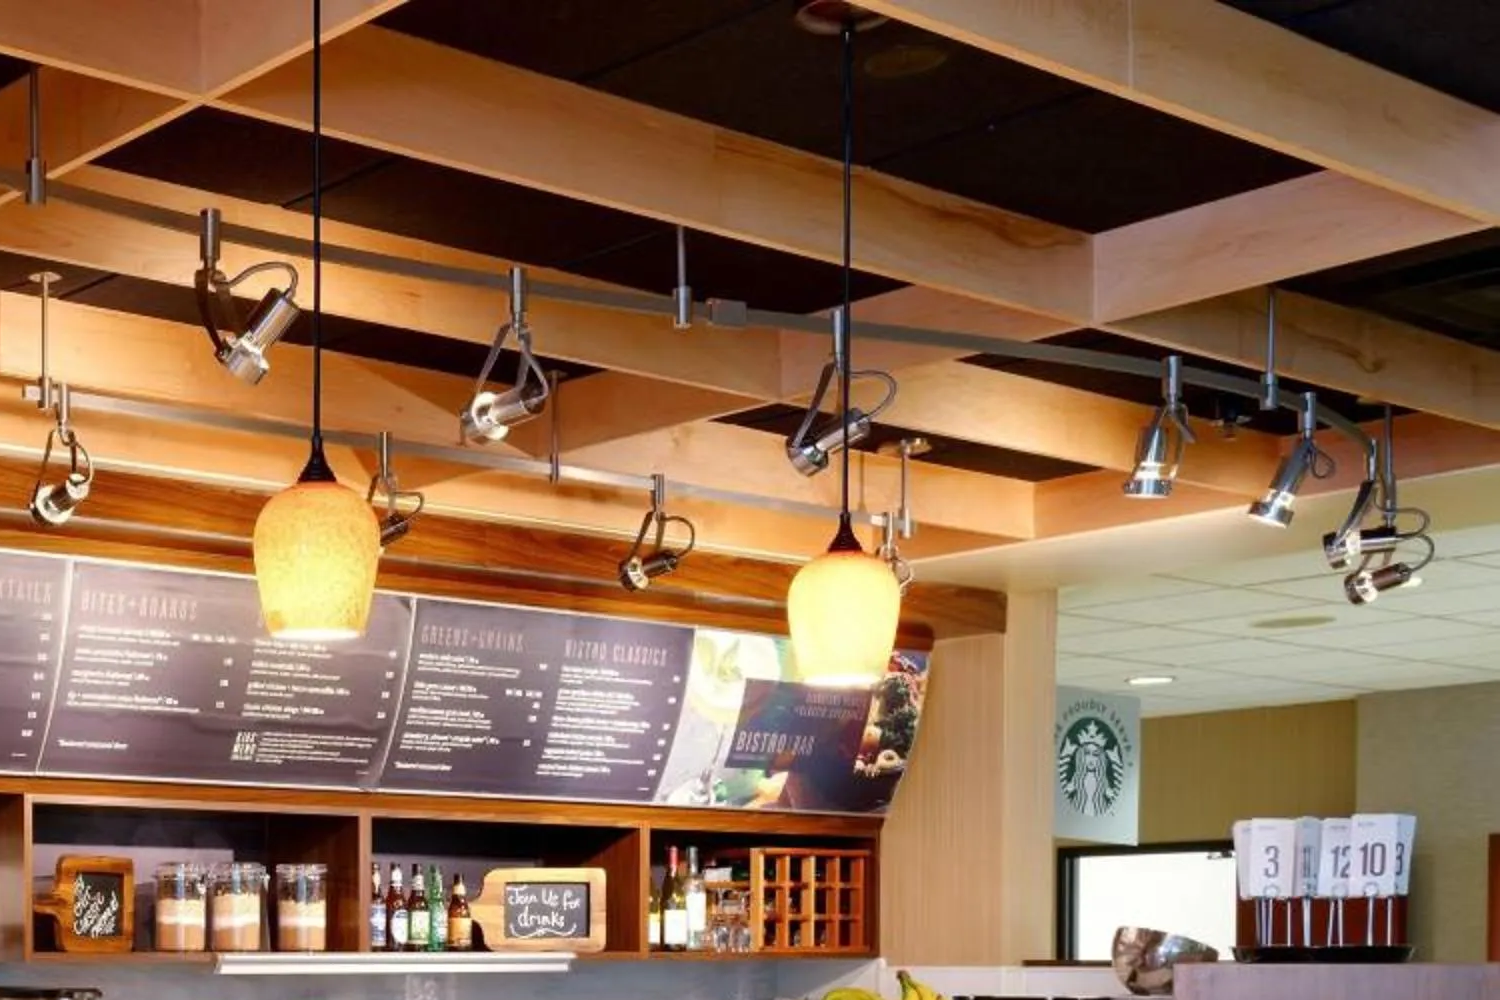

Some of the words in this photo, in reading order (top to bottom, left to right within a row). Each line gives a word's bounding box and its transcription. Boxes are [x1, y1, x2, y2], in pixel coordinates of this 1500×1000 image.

[139, 596, 198, 621] BOARDS
[565, 639, 607, 660] BISTRO
[613, 643, 668, 667] CLASSICS
[736, 730, 788, 754] BISTRO
[1264, 845, 1280, 878] 3
[1330, 845, 1352, 878] 12
[1359, 842, 1387, 877] 10
[518, 905, 565, 928] drinks
